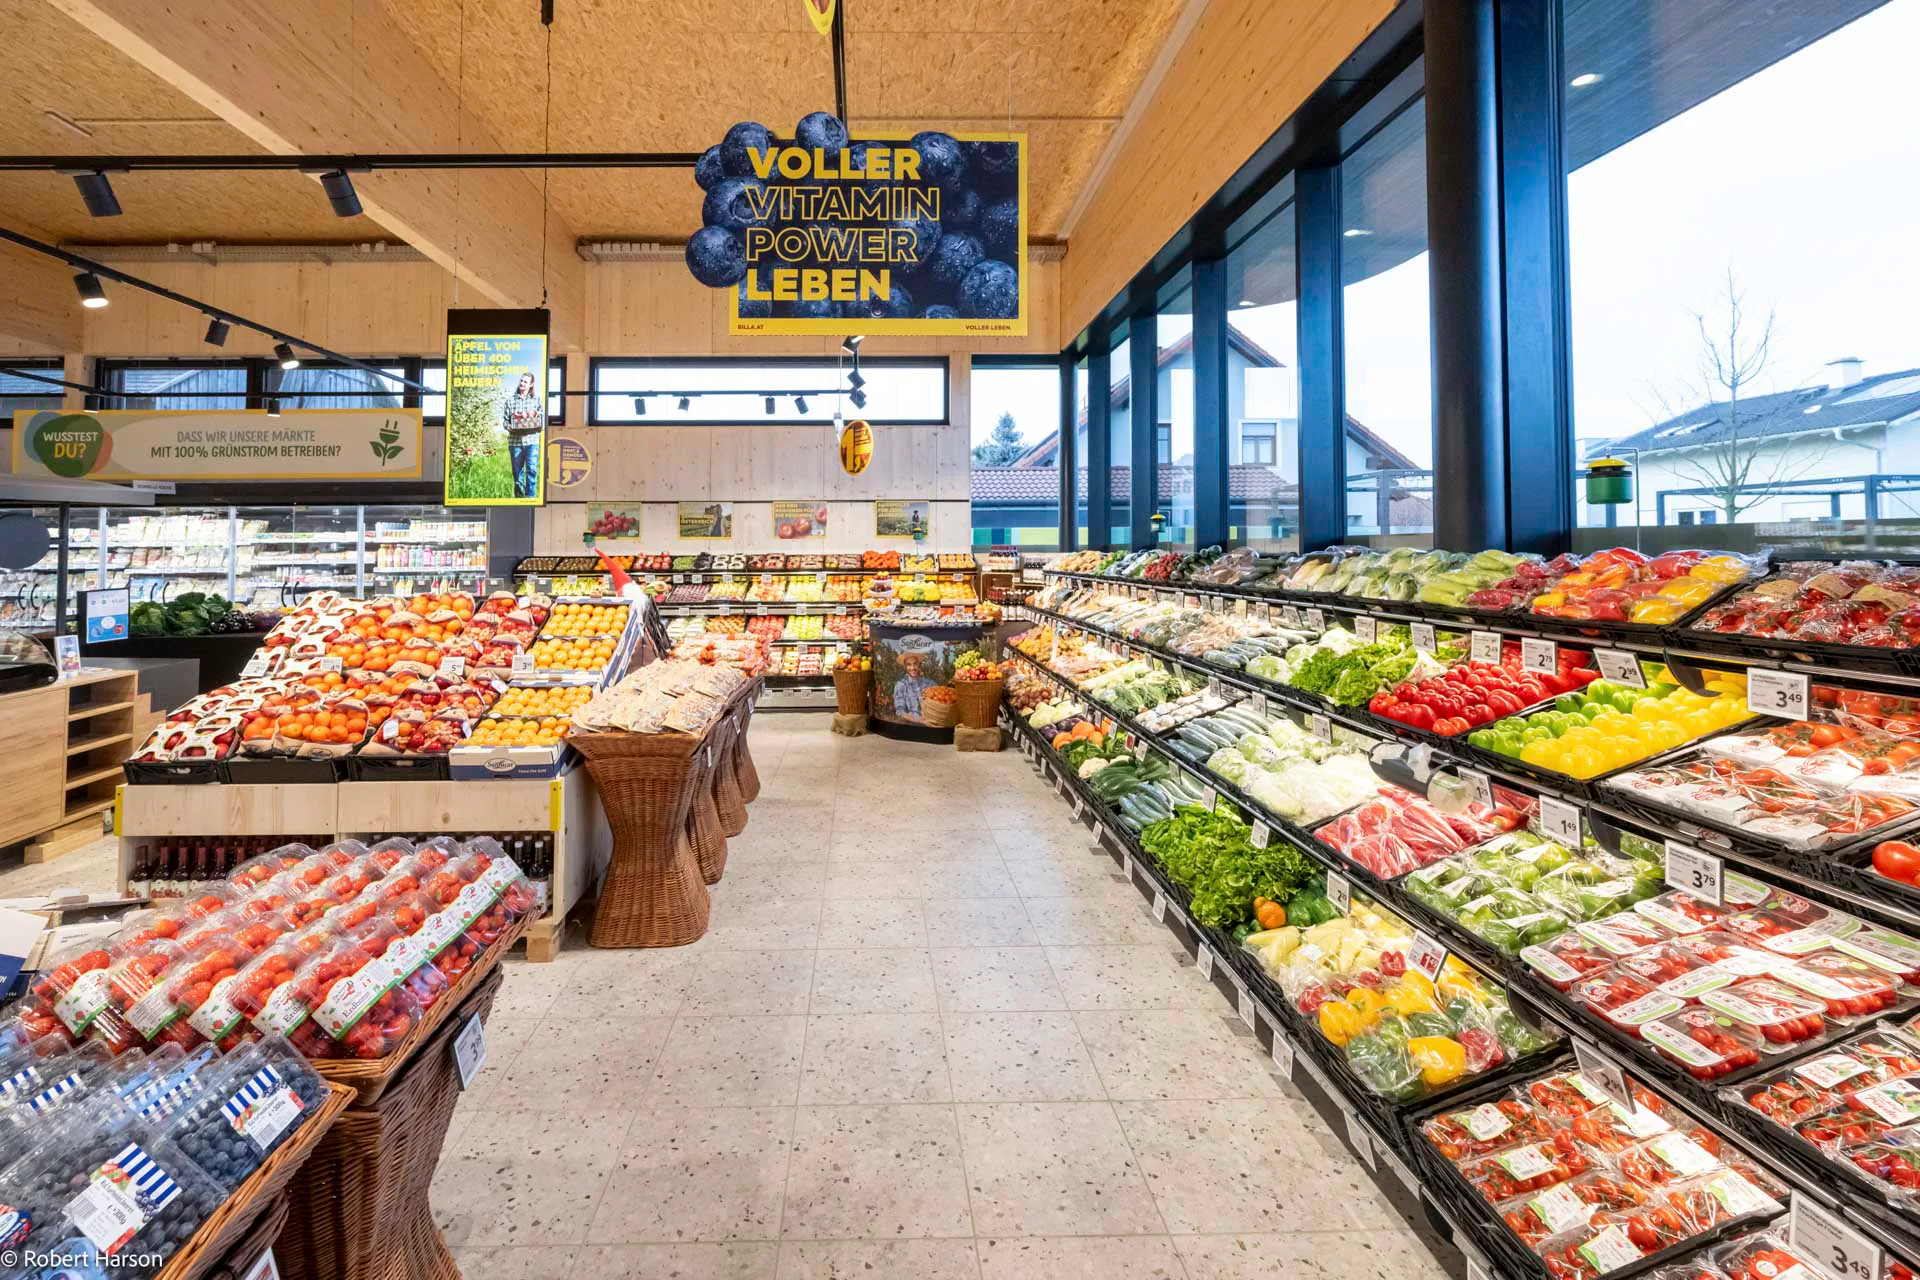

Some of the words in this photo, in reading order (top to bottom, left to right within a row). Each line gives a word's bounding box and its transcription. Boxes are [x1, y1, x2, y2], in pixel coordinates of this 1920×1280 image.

[746, 147, 922, 180] VOLLER
[744, 186, 940, 221] VITAMIN
[746, 228, 918, 262] POWER
[746, 269, 891, 301] LEBEN
[454, 338, 491, 351] ÄPFEL
[494, 341, 521, 351] VON
[454, 350, 486, 363] ÜBER
[488, 353, 512, 363] 400
[454, 365, 529, 375] HEIMISCHEN
[453, 377, 501, 388] BAUERN
[43, 430, 99, 443] WUSSTEST
[176, 430, 202, 443] DASS
[204, 430, 226, 443] WIR
[228, 430, 270, 443] UNSERE
[272, 427, 316, 442] MÄRKTE
[53, 441, 86, 458] DU?
[151, 446, 172, 458] MIT
[174, 446, 209, 458] 100%
[211, 444, 278, 457] GRÜNSTROM
[280, 445, 341, 457] BETREIBEN?
[900, 637, 932, 650] SanLucar
[1775, 690, 1803, 708] 349
[1692, 870, 1716, 889] 379
[1831, 1245, 1870, 1279] 349
